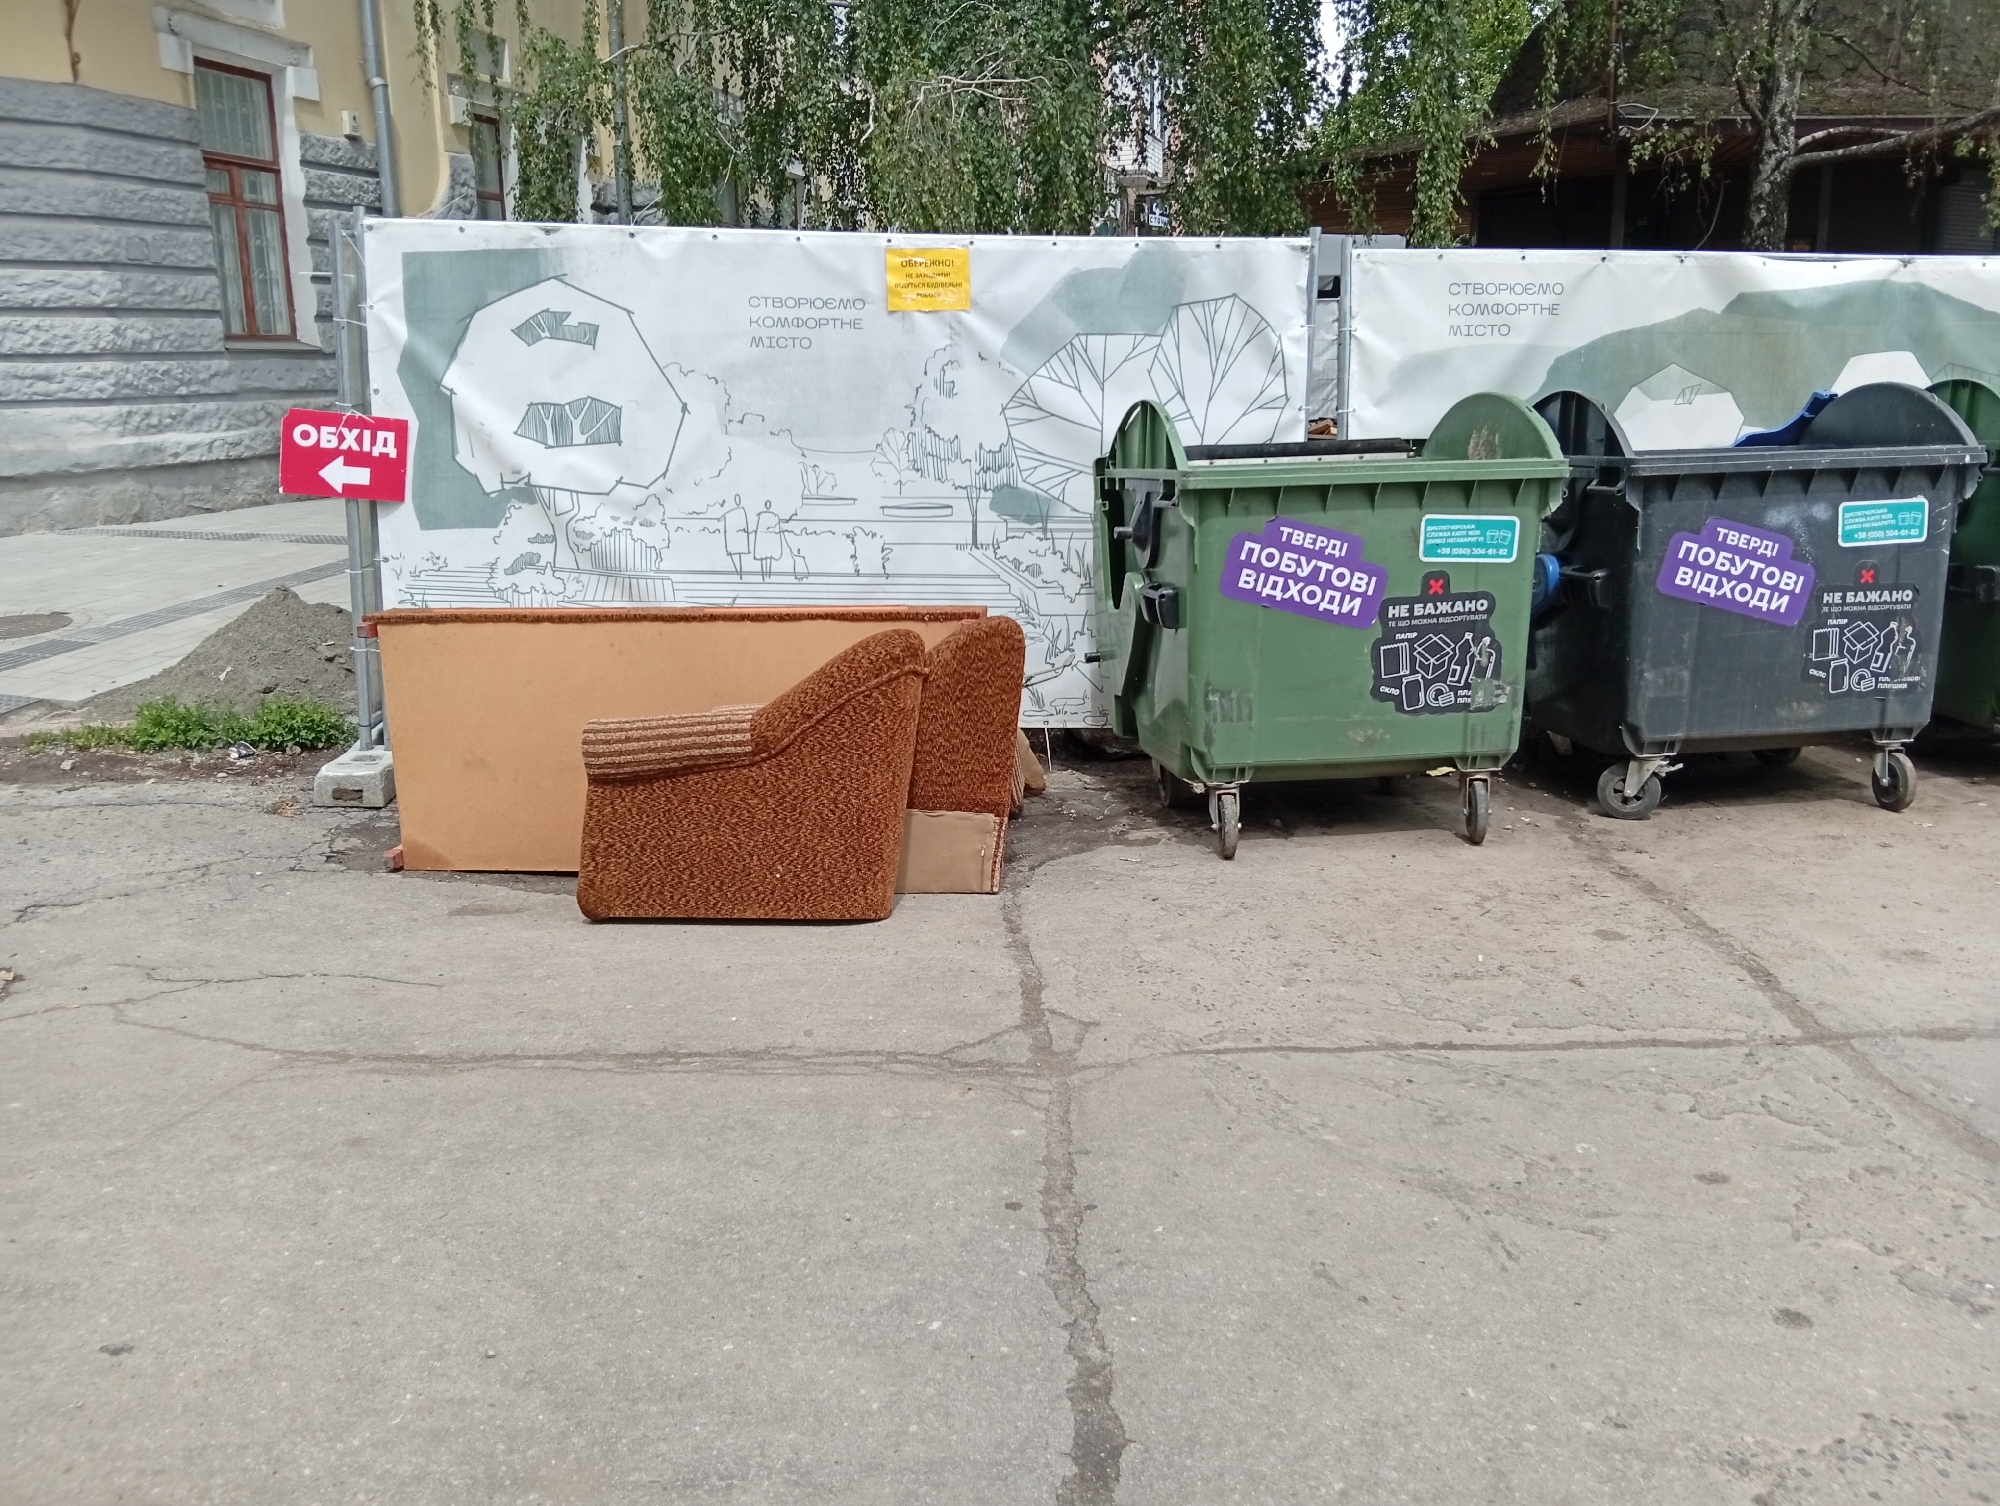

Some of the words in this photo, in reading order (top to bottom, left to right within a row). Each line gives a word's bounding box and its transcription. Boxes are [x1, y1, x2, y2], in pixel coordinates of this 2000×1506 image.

[900, 258, 954, 268] ОБЕРЕЖНО!
[1448, 282, 1565, 296] СТВОРЮЄМО
[748, 296, 866, 310] СТВОРЮЄМО
[1448, 303, 1561, 316] КОМФОРТНЕ
[749, 316, 864, 330] КОМФОРТНЕ
[1448, 324, 1511, 337] МІСТО
[750, 336, 812, 350] МІСТО
[292, 424, 397, 459] ОБХІД
[1854, 531, 1867, 539] +38
[1867, 530, 1885, 539] (050)
[1885, 528, 1919, 537] 304-61-82
[1279, 526, 1349, 559] ТВЕРДІ
[1716, 526, 1780, 558] ТВЕРДІ
[1437, 547, 1451, 555] +38
[1451, 547, 1471, 556] (050)
[1239, 540, 1378, 596] ПОБУТОВІ
[1677, 540, 1805, 594] ПОБУТОВІ
[1237, 567, 1363, 617] ВІДХОДИ
[1674, 566, 1790, 614] ВІДХОДИ
[1823, 592, 1843, 604] НЕ
[1845, 590, 1913, 603] БАЖАНО
[1387, 604, 1410, 619] НЕ
[1413, 599, 1489, 617] БАЖАНО
[1830, 605, 1842, 613] ЩО
[1867, 603, 1911, 611] ВІДСОРТУВАТИ
[1398, 619, 1410, 627] ЩО
[1411, 616, 1438, 626] МОЖНА
[1438, 613, 1488, 624] ВІДСОРТУВАТИ
[1395, 632, 1418, 640] ПАПІР
[1808, 668, 1827, 678] СКЛО
[1379, 685, 1400, 696] СКЛО
